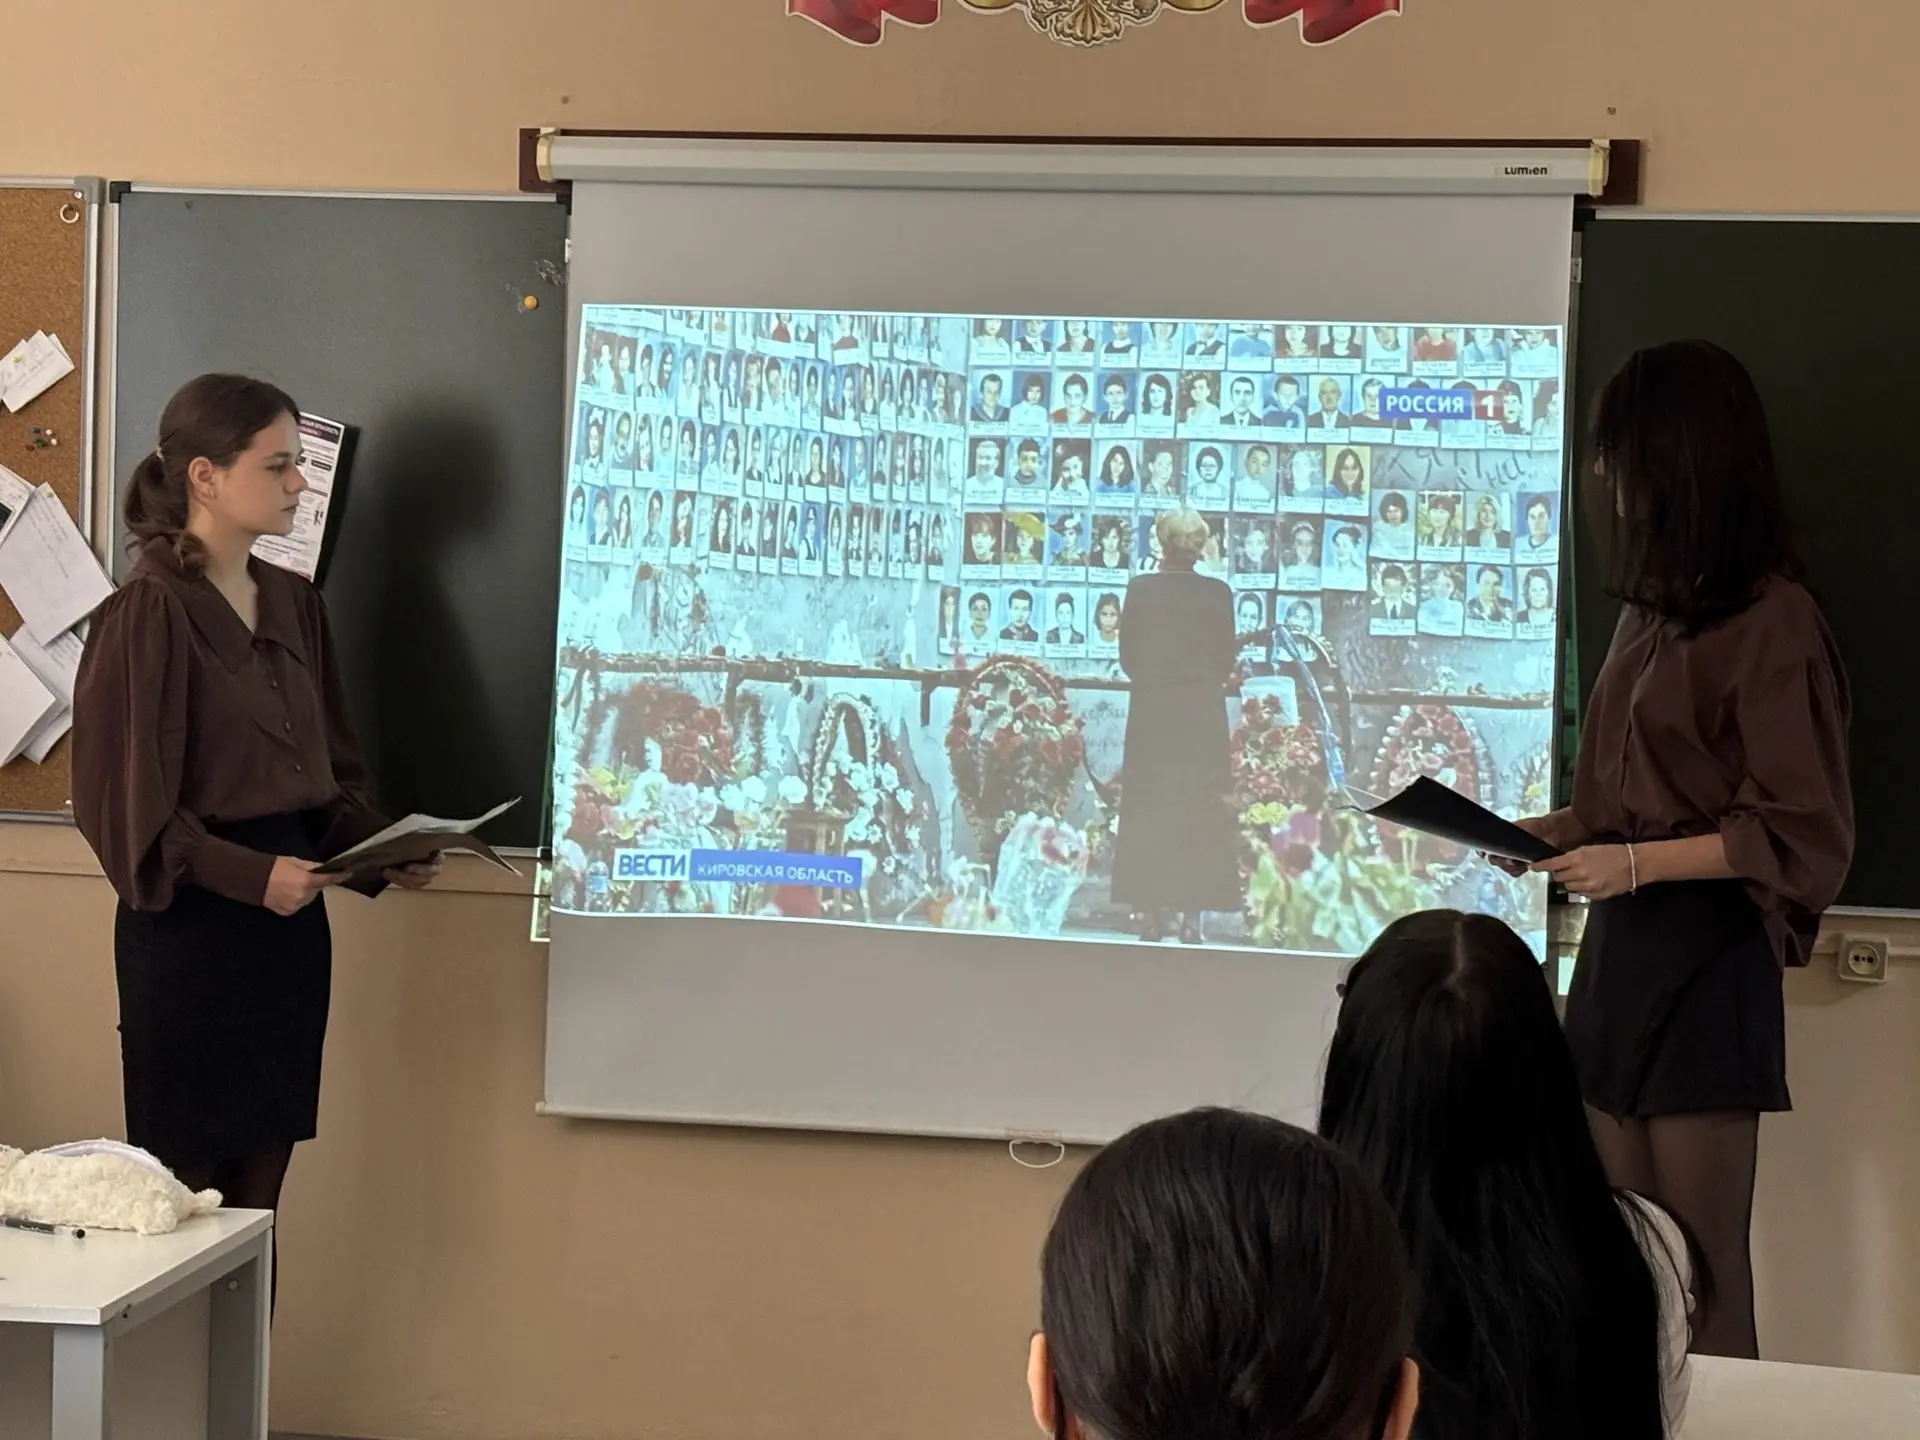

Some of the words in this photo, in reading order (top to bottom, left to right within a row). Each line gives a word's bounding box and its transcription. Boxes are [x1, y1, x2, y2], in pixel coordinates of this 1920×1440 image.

[1386, 395, 1465, 413] РОССИЯ
[1481, 395, 1494, 417] 1
[618, 854, 686, 877] ВЕСТИ
[697, 863, 784, 878] КИРОВСКАЯ
[787, 867, 854, 884] ОБЛАСТЬ
